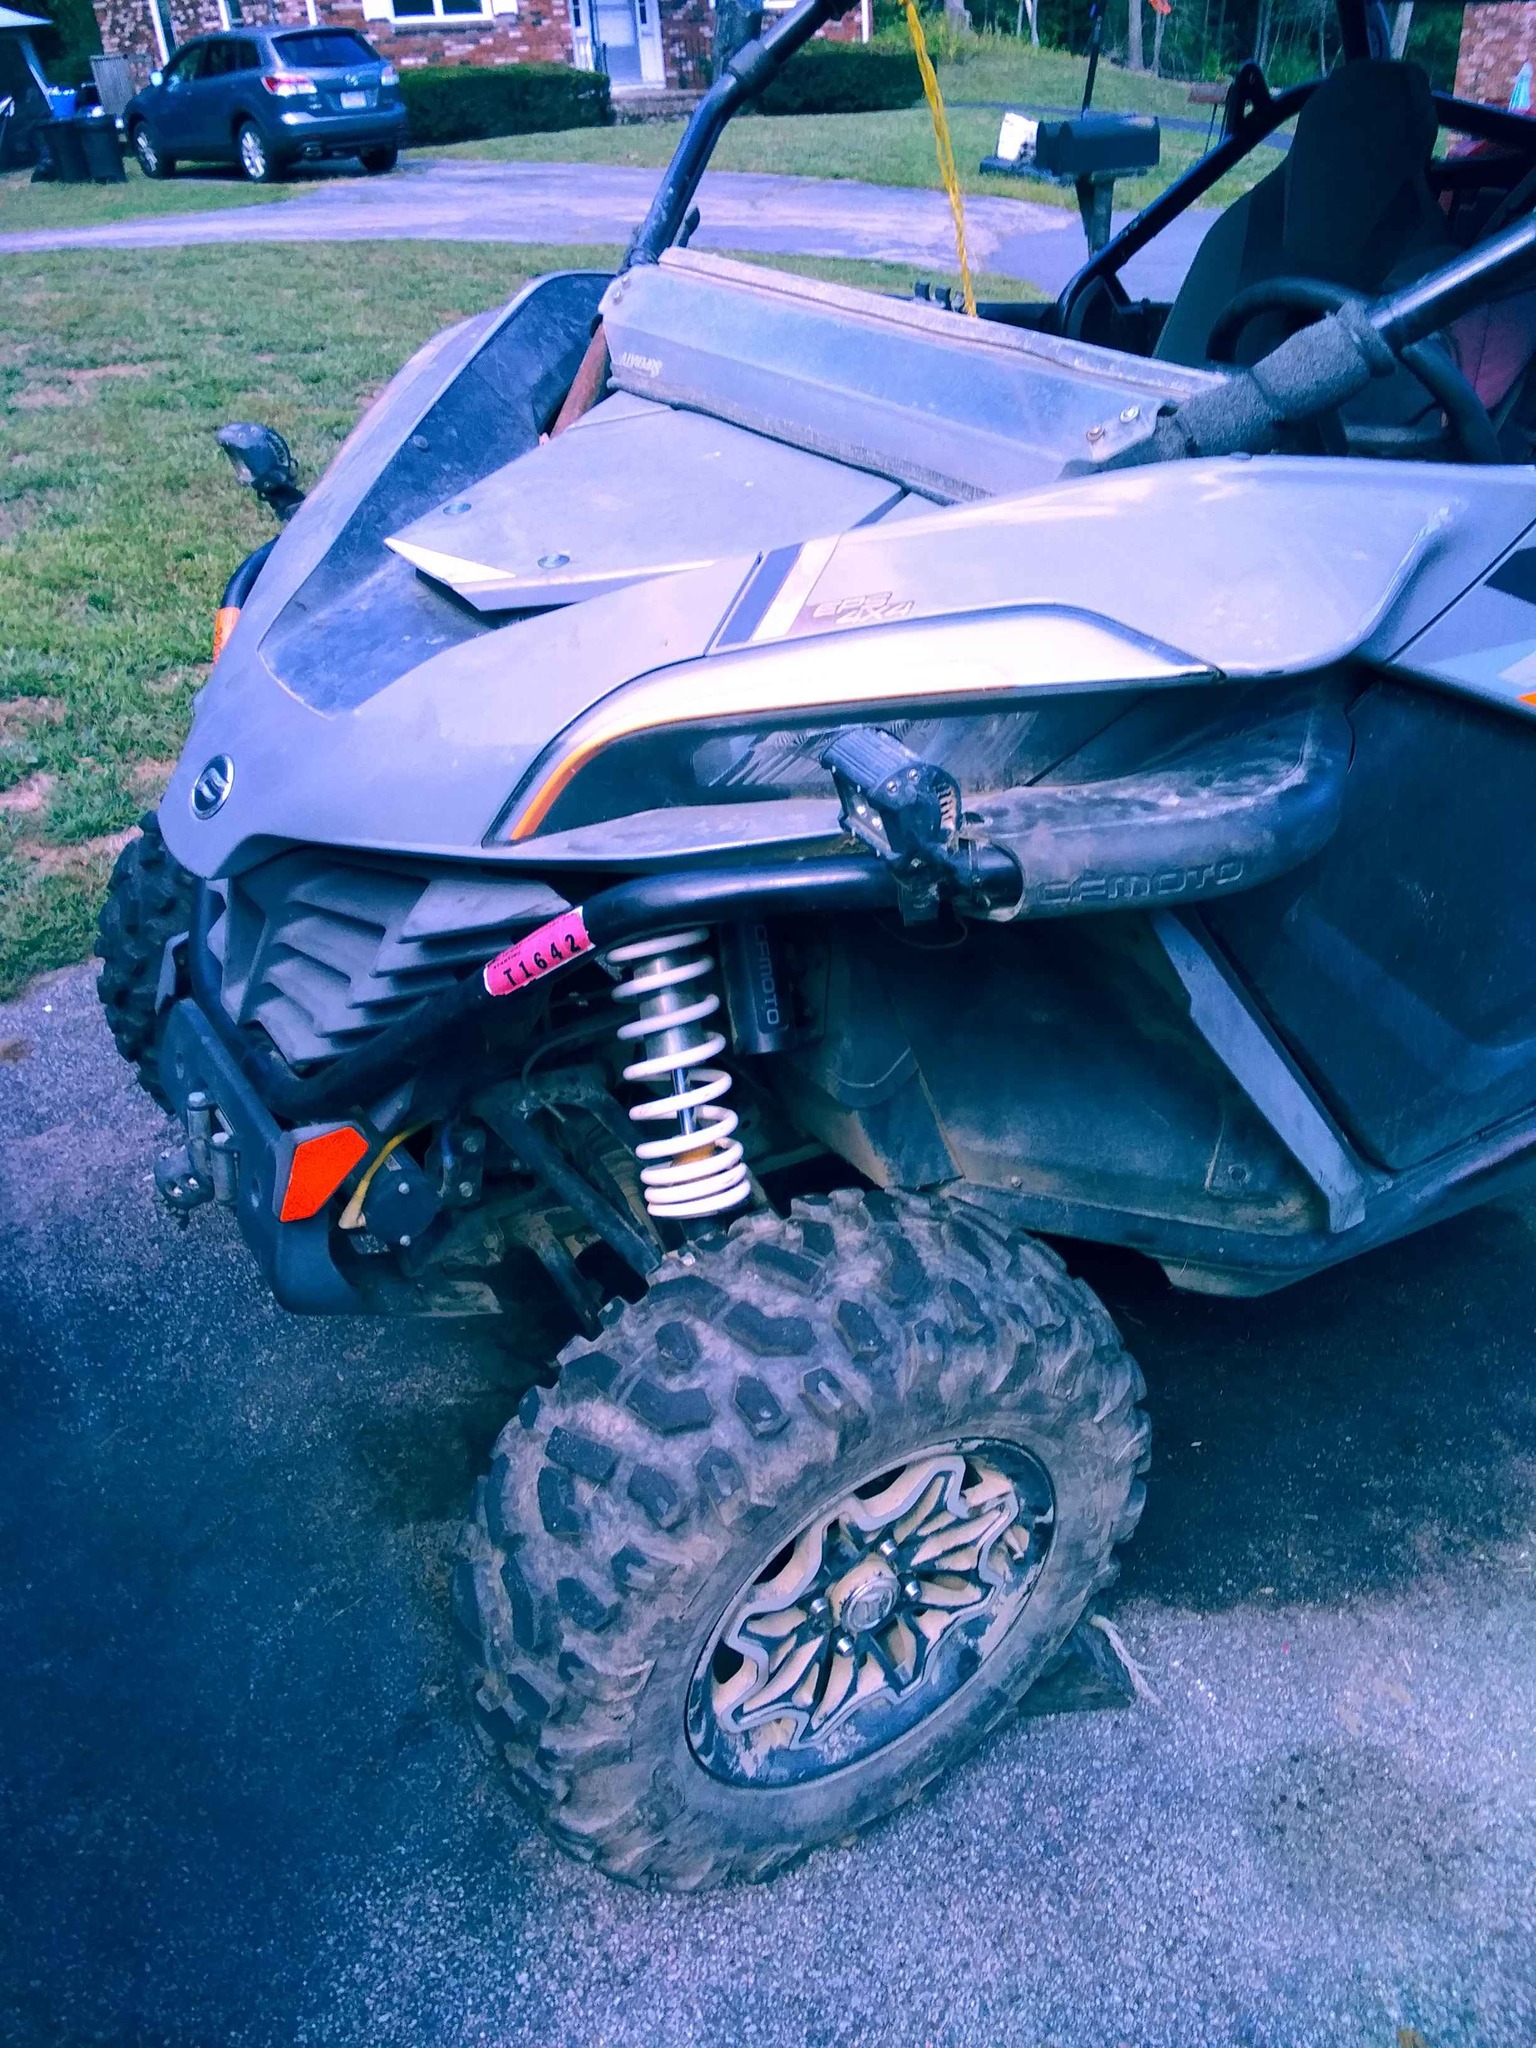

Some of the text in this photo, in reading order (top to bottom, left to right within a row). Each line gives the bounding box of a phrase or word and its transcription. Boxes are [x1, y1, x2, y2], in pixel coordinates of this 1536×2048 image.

[1037, 861, 1244, 904] CFMOTO
[503, 934, 580, 987] T1642
[754, 924, 780, 1025] CFMOTO
